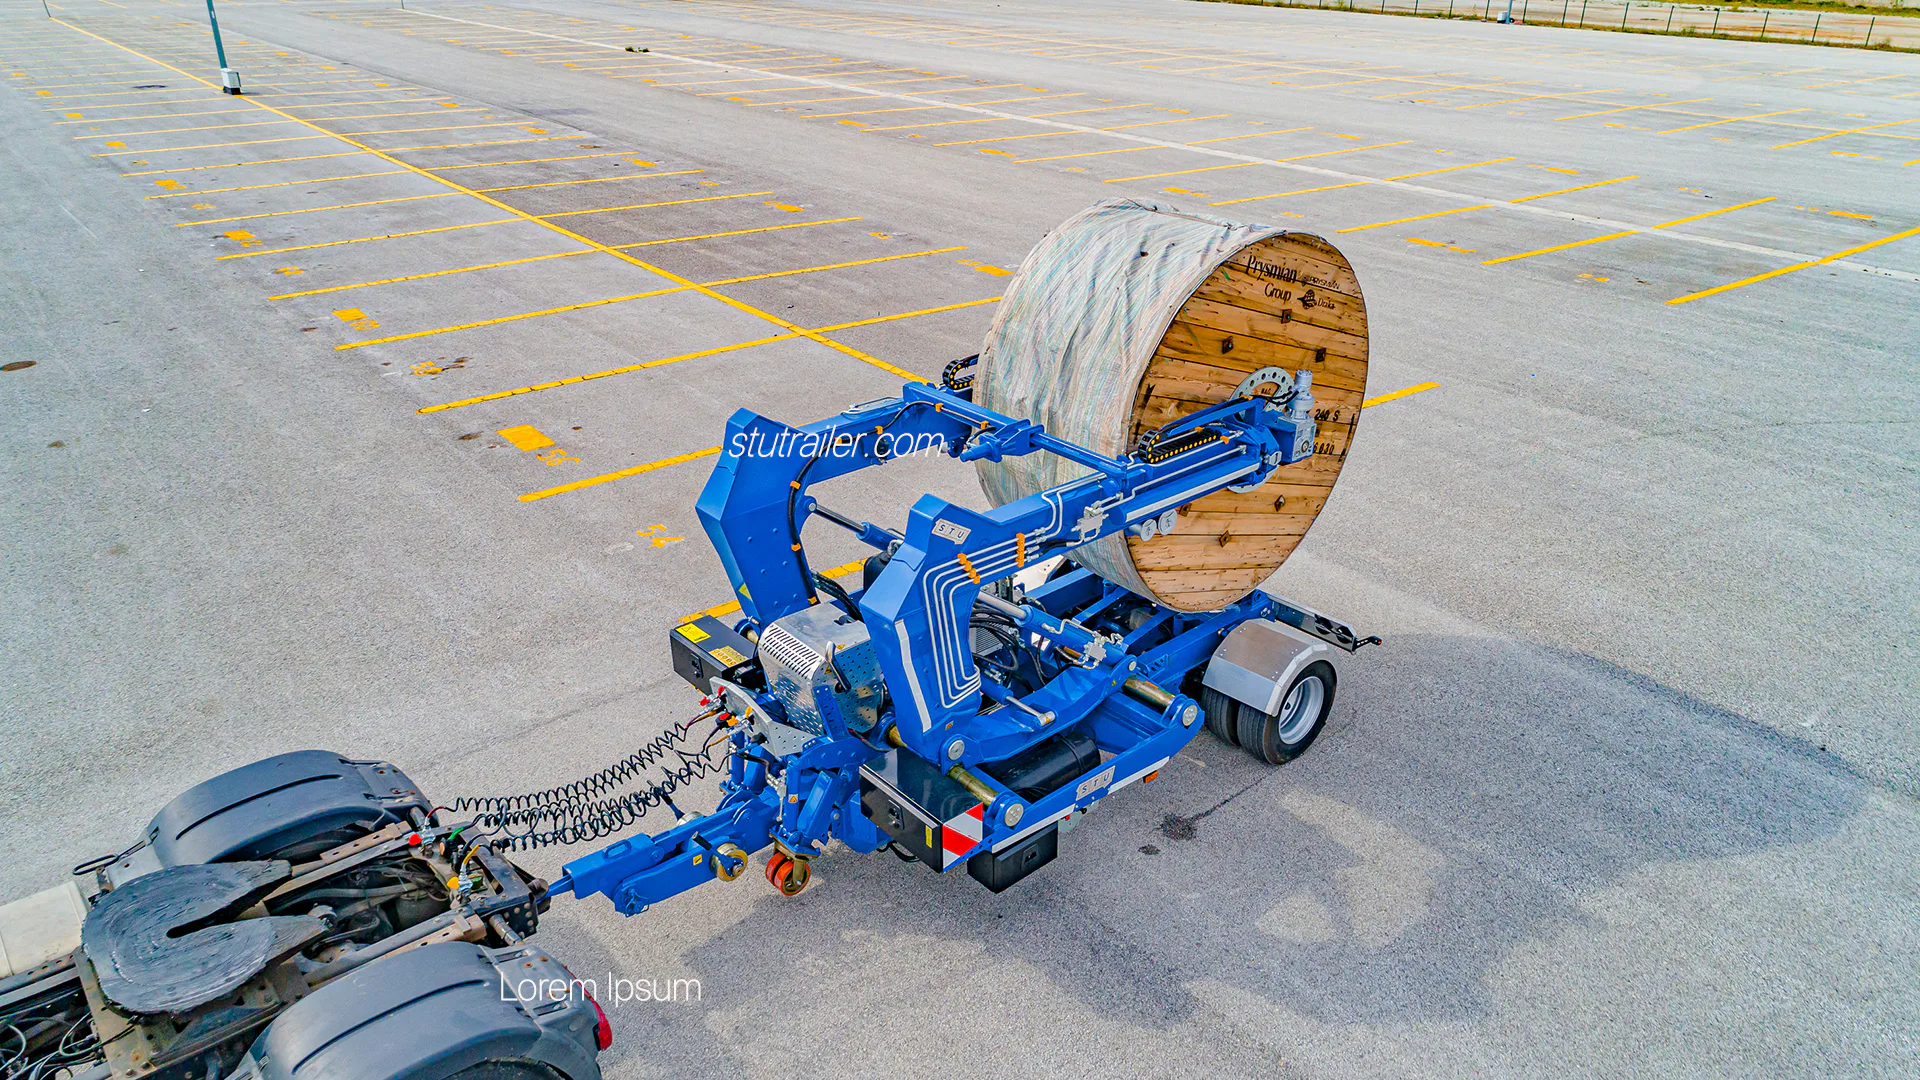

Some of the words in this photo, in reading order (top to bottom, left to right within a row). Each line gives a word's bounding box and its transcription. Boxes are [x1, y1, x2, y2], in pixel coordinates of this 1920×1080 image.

[1246, 253, 1297, 283] Prysmian
[1264, 282, 1291, 304] Group
[536, 448, 580, 467] 56
[636, 523, 686, 549] 54
[938, 524, 965, 539] STU
[1081, 773, 1110, 794] STU
